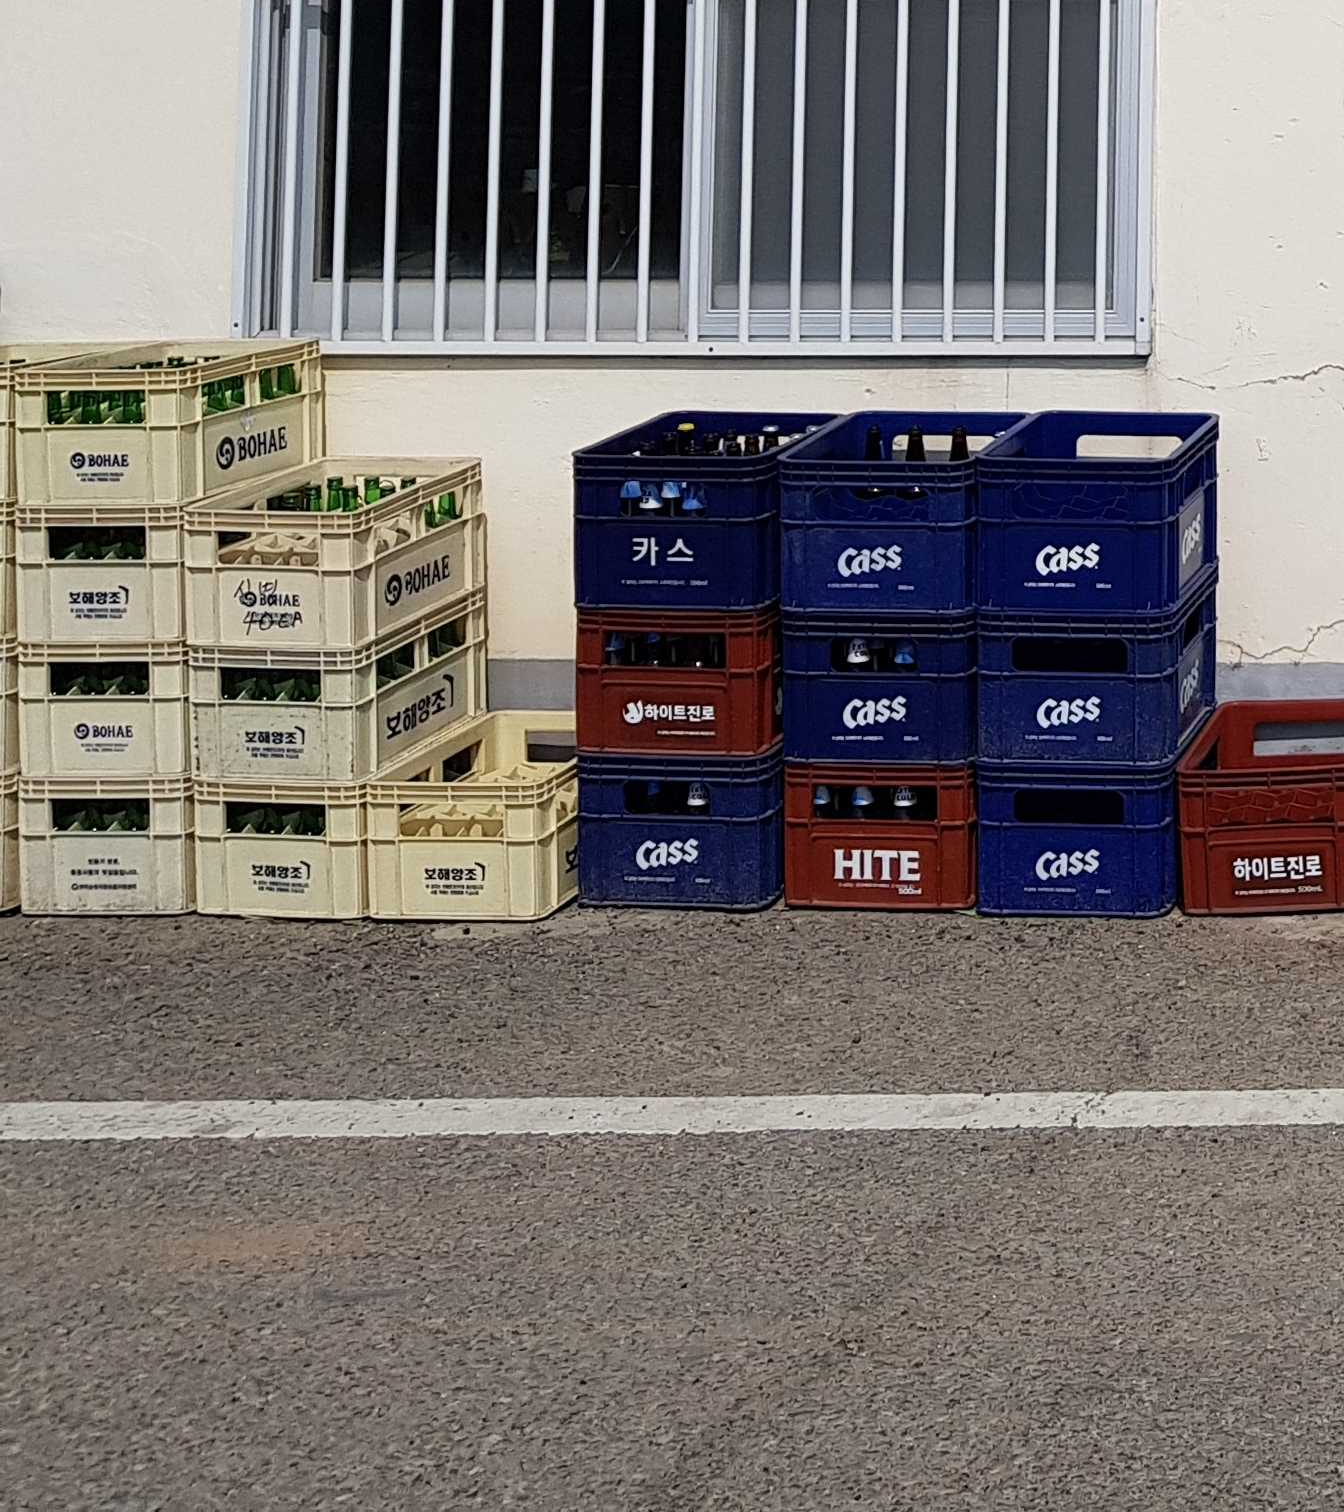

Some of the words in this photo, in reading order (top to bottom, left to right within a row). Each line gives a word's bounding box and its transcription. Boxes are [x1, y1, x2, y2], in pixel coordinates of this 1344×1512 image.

[88, 454, 129, 467] BOHAE
[237, 426, 288, 462] BOHAE
[404, 555, 451, 595] BOHAE
[837, 544, 903, 577] Cass
[1035, 542, 1101, 576] Cass
[69, 591, 121, 605] 보해양조
[386, 687, 447, 740] 보해양조
[644, 703, 716, 722] 하이트진로
[842, 695, 907, 729] Cass
[1036, 695, 1101, 729] Cass
[92, 725, 134, 738] BOHAE
[244, 730, 298, 745] 보해양조
[635, 838, 699, 871] Cass
[833, 848, 921, 881] HITE
[1035, 848, 1101, 881] Cass
[1232, 855, 1323, 882] 하이트진로
[251, 864, 303, 879] 보해양조
[424, 868, 478, 881] 보해양조
